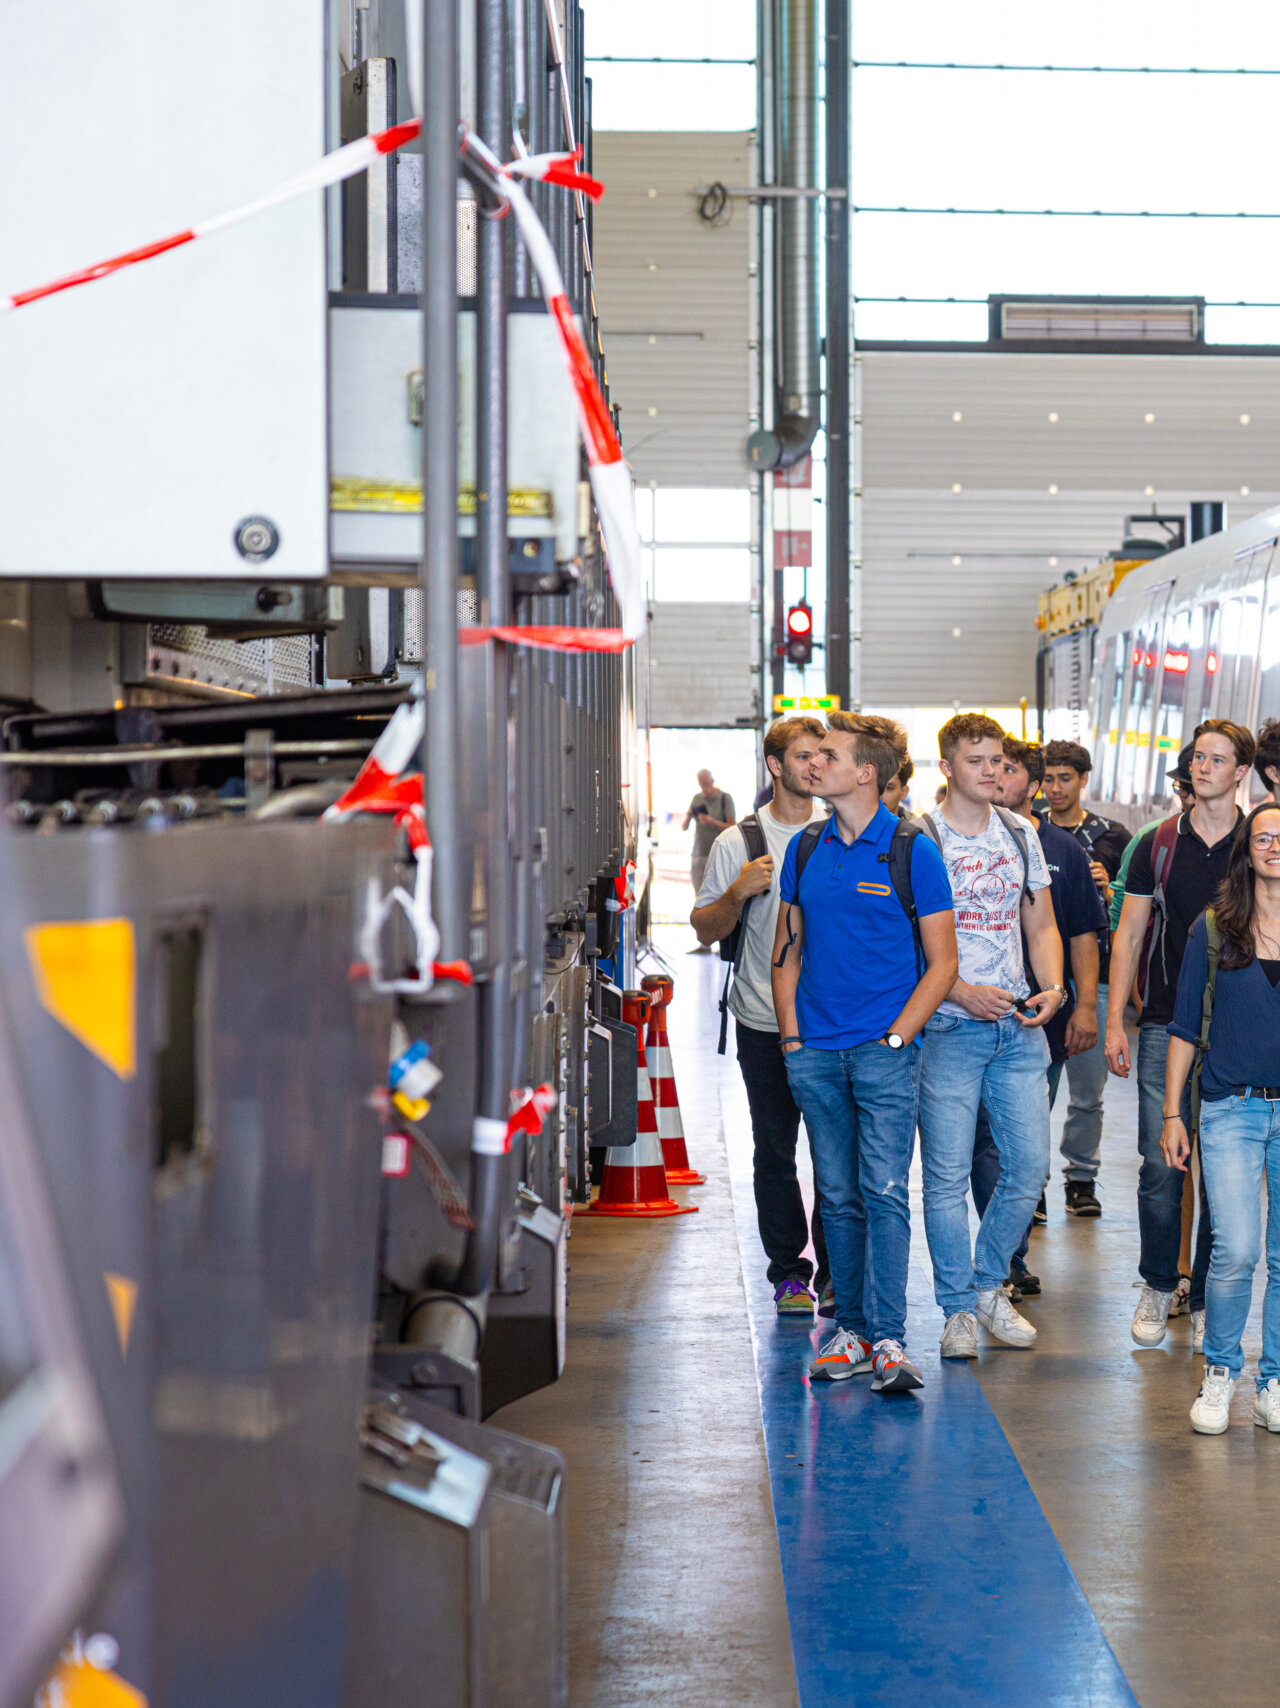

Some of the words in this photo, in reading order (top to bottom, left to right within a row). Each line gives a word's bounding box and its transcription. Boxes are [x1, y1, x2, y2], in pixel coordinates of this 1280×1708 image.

[952, 856, 982, 876] Fresh
[987, 850, 1019, 872] Start
[1047, 864, 1060, 872] OM
[958, 911, 983, 921] WORK
[985, 910, 1002, 921] JUST
[986, 922, 1012, 931] GARMENTS
